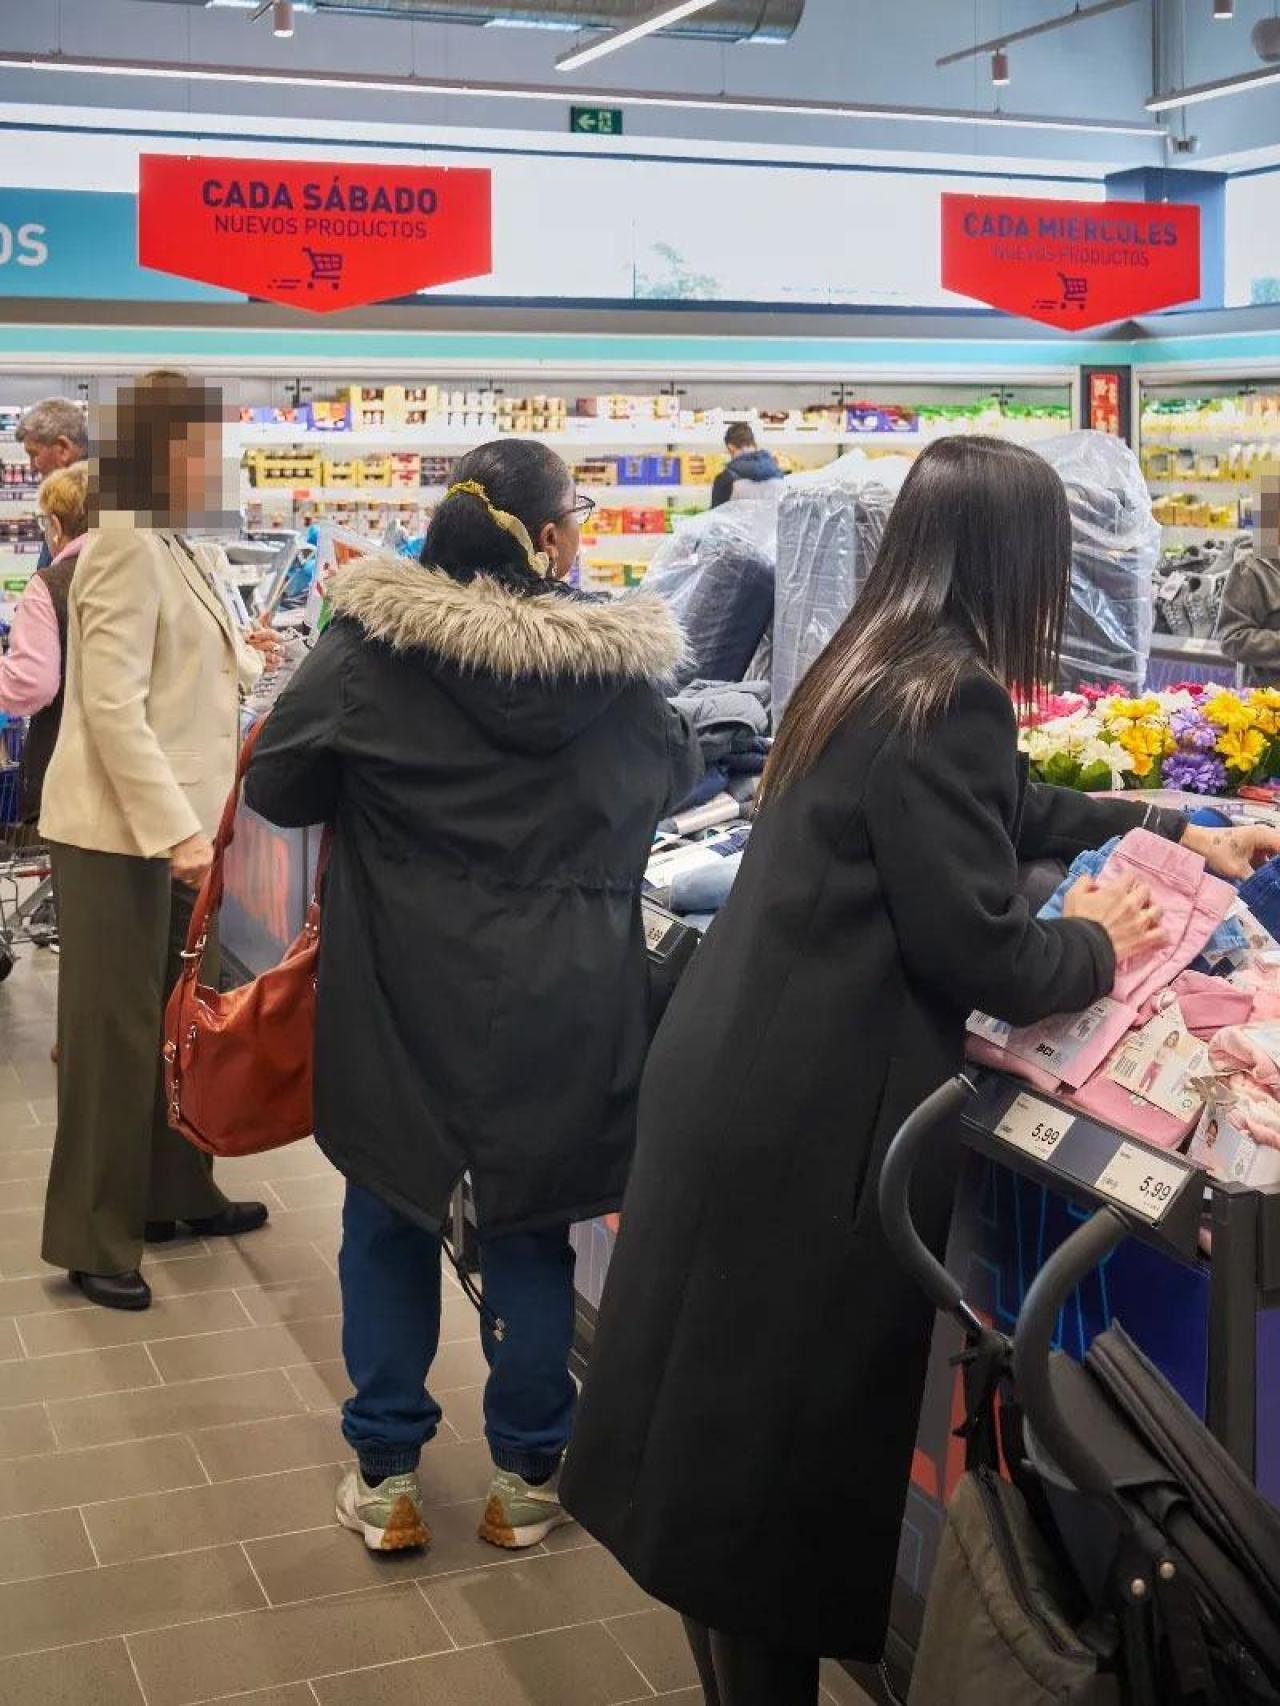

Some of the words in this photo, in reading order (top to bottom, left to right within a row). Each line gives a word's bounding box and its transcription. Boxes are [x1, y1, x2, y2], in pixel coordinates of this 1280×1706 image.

[202, 178, 294, 209] CADA
[302, 176, 438, 215] SÁBADO
[214, 215, 298, 235] NUEVOS
[304, 217, 428, 239] PRODUCTOS
[963, 212, 1030, 238] CADA
